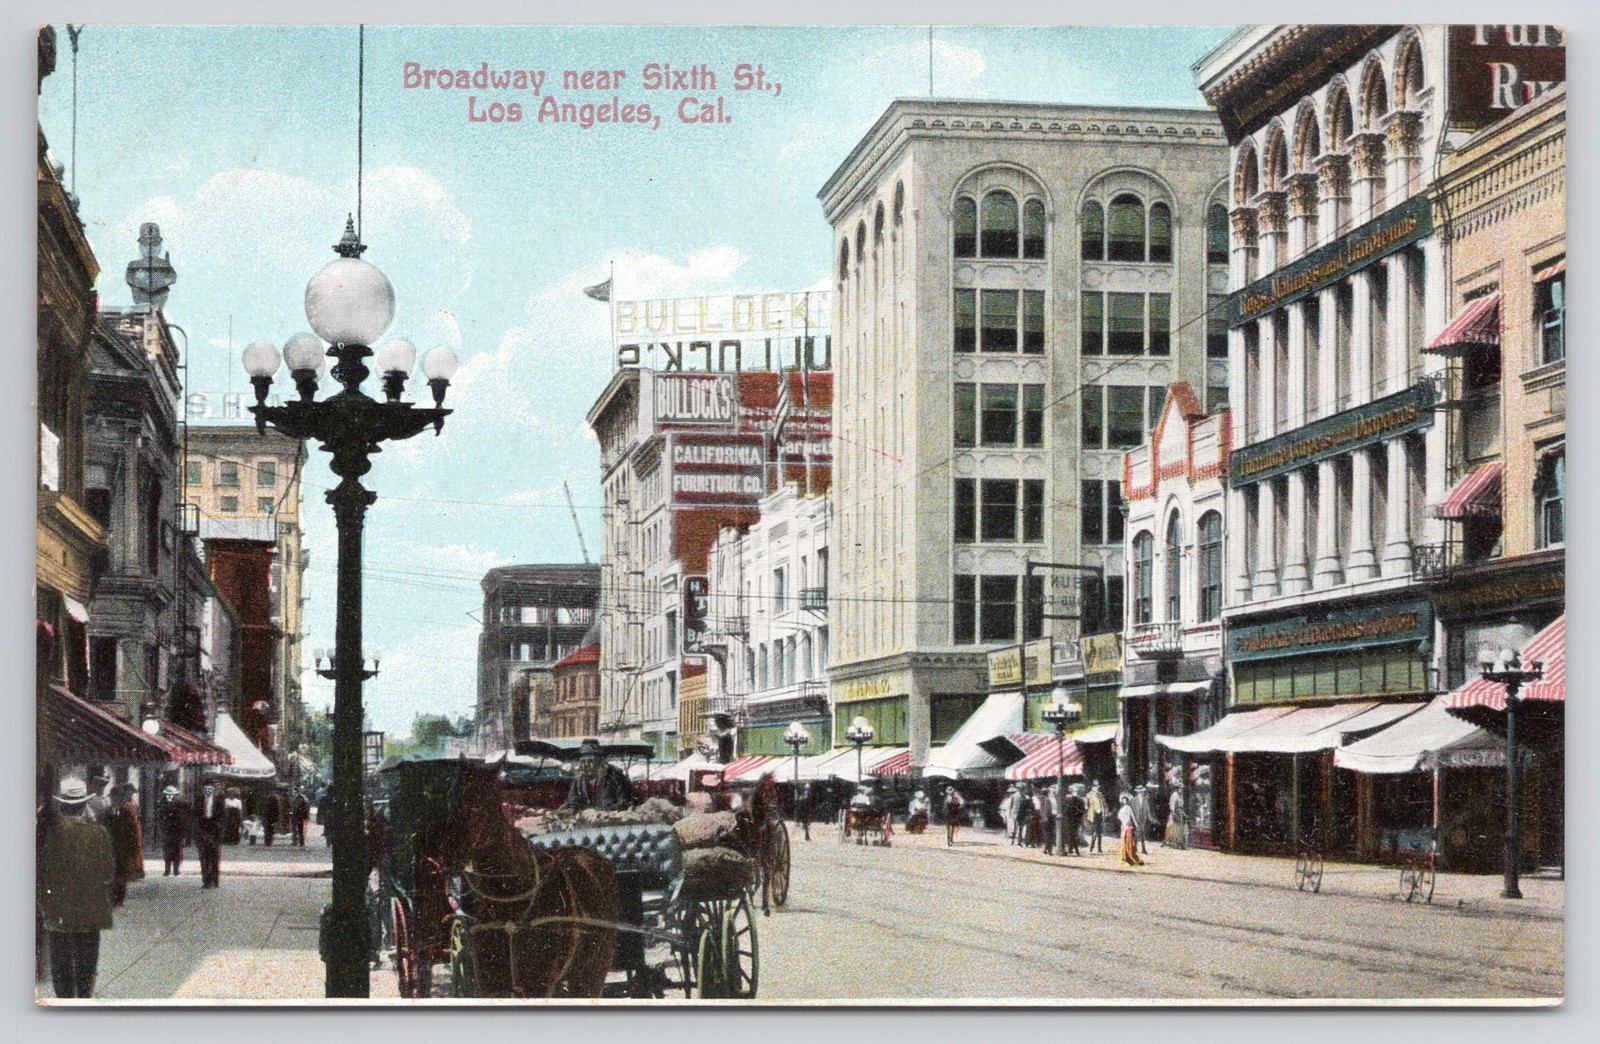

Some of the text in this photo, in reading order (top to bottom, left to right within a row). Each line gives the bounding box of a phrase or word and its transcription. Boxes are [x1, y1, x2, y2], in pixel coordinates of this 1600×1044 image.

[657, 377, 731, 419] BULLOCK'S
[674, 445, 761, 465] CALIFORNIA
[743, 475, 763, 493] CO.
